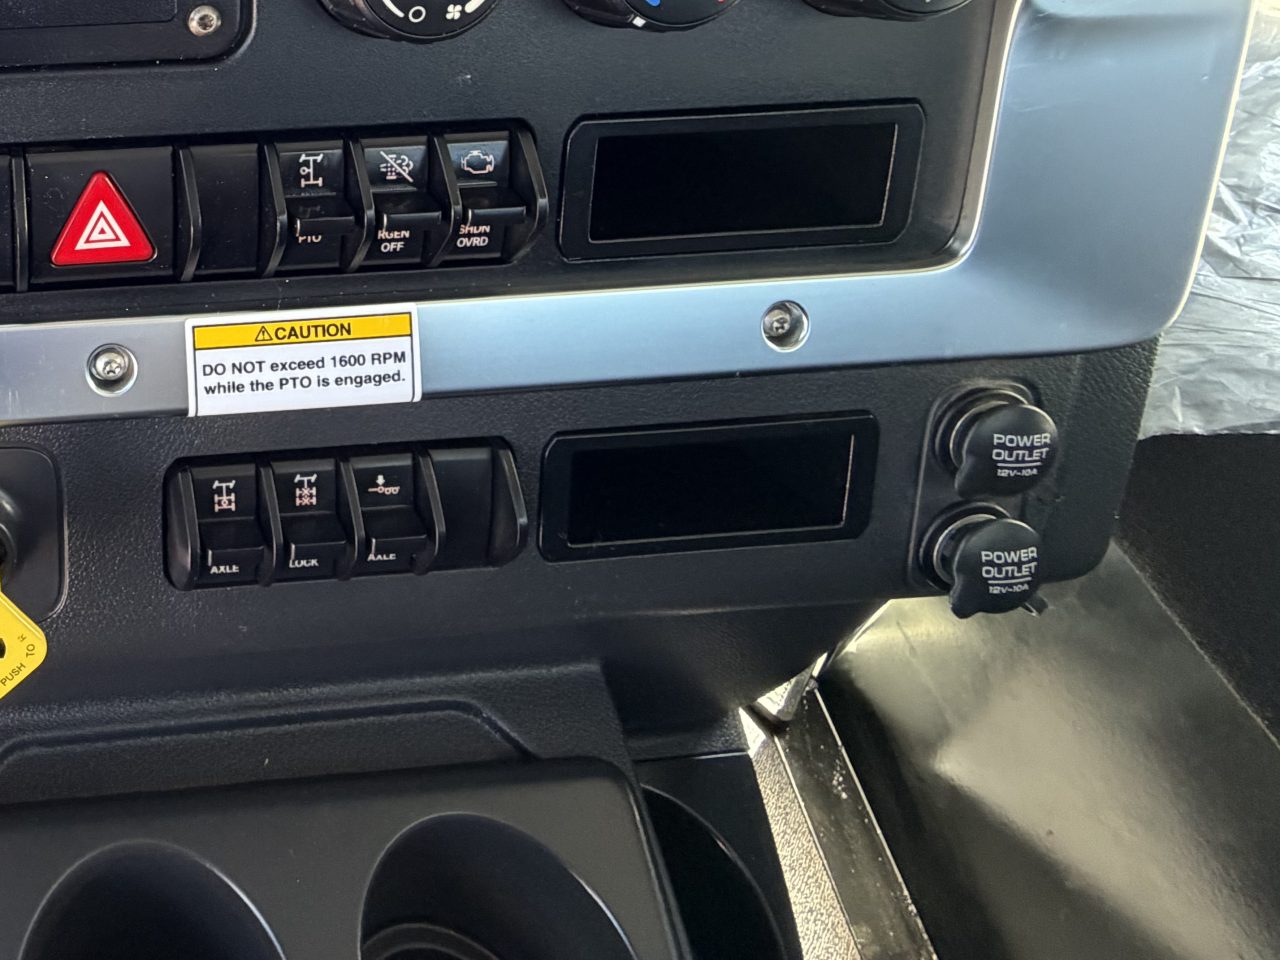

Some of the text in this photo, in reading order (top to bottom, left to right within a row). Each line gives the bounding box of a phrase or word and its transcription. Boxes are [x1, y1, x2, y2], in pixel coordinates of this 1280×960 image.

[380, 241, 405, 253] OFF
[456, 236, 489, 248] OVRD
[274, 322, 352, 341] CAUTION
[202, 351, 406, 377] DO NOT exceed 1600 RPM
[204, 369, 406, 395] while the PTO is engaged.
[993, 433, 1051, 447] POWER
[992, 447, 1049, 461] OUTLET
[996, 468, 1038, 477] 12V-10A
[981, 546, 1038, 564] POWER
[209, 564, 240, 575] AXLE
[288, 558, 319, 569] LOCK
[981, 561, 1038, 578] OUTLET
[988, 583, 1030, 594] 12V-10A
[0, 662, 26, 687] PUSH
[25, 643, 36, 658] TO
